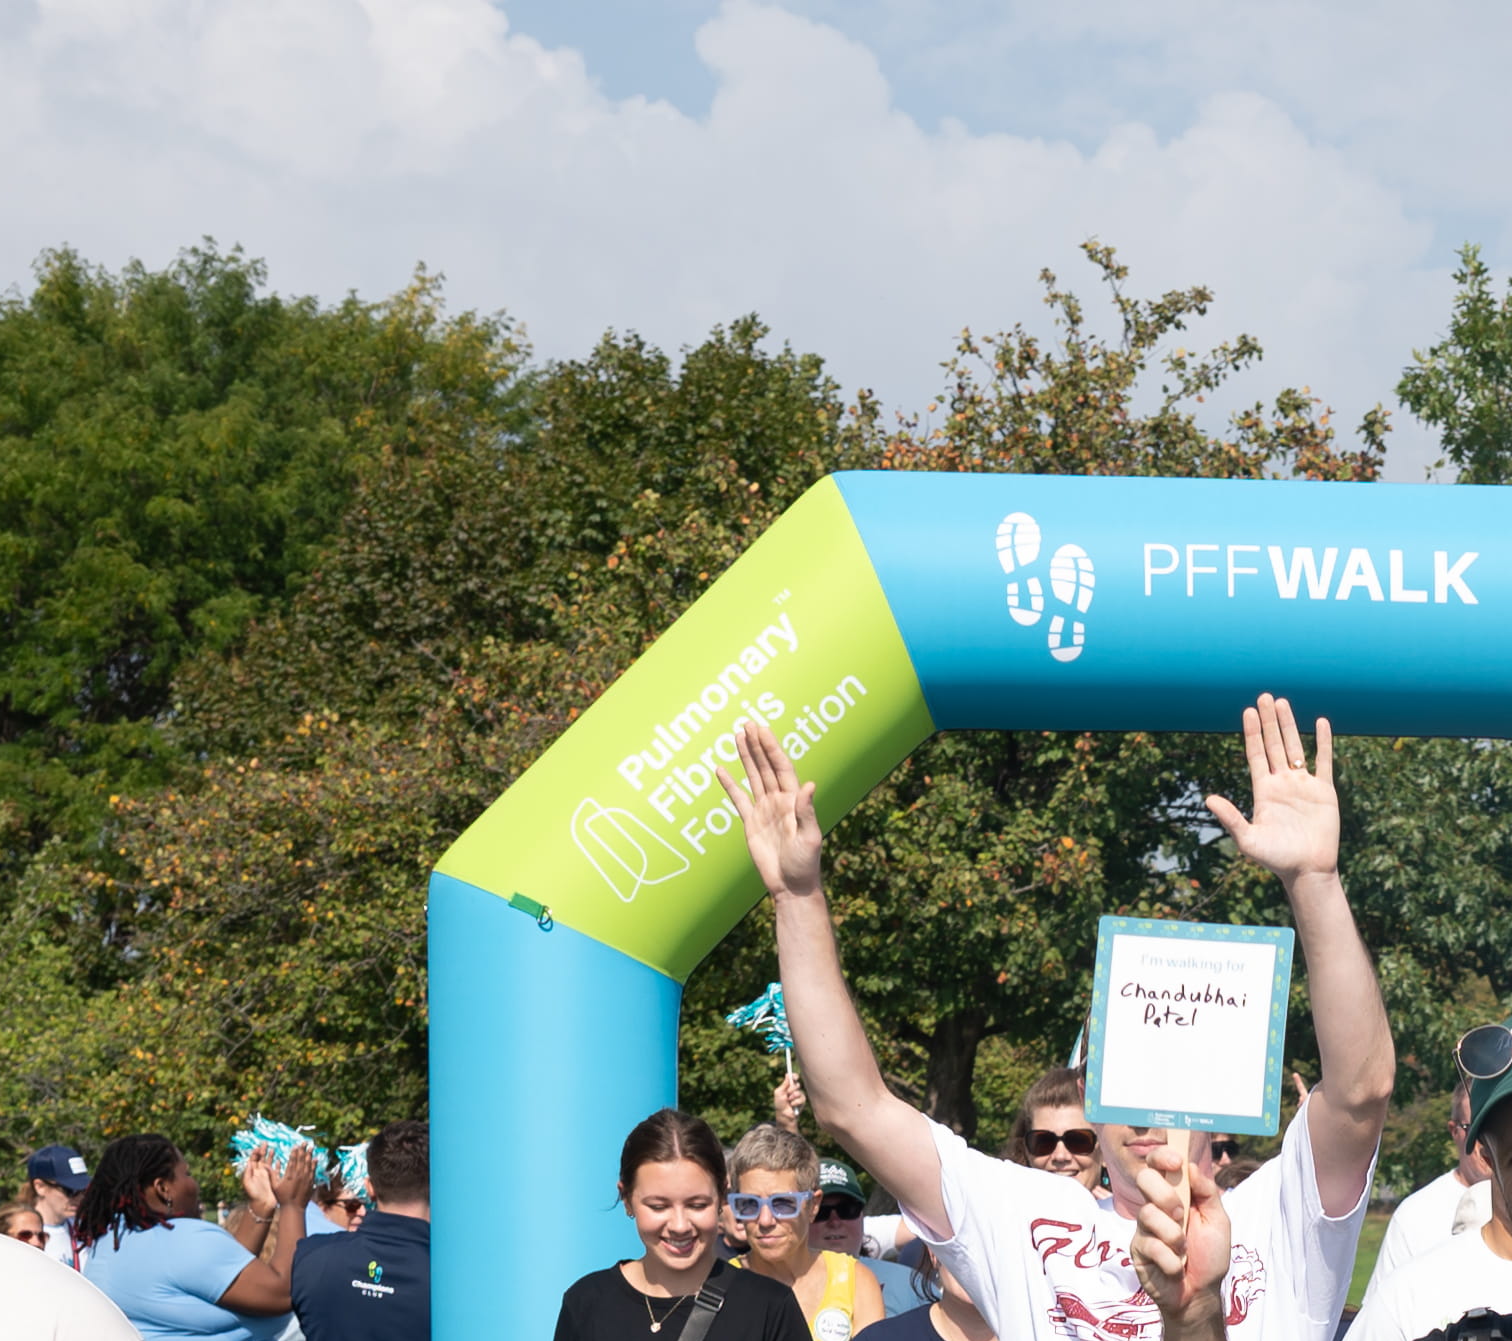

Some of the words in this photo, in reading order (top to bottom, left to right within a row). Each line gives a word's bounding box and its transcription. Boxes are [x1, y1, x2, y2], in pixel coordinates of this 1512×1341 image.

[1144, 543, 1480, 605] PFFWALK
[616, 612, 799, 791] Pulmonary
[680, 675, 868, 855] Foation
[1121, 982, 1247, 1008] Chandubhai
[1144, 1003, 1197, 1027] Patel
